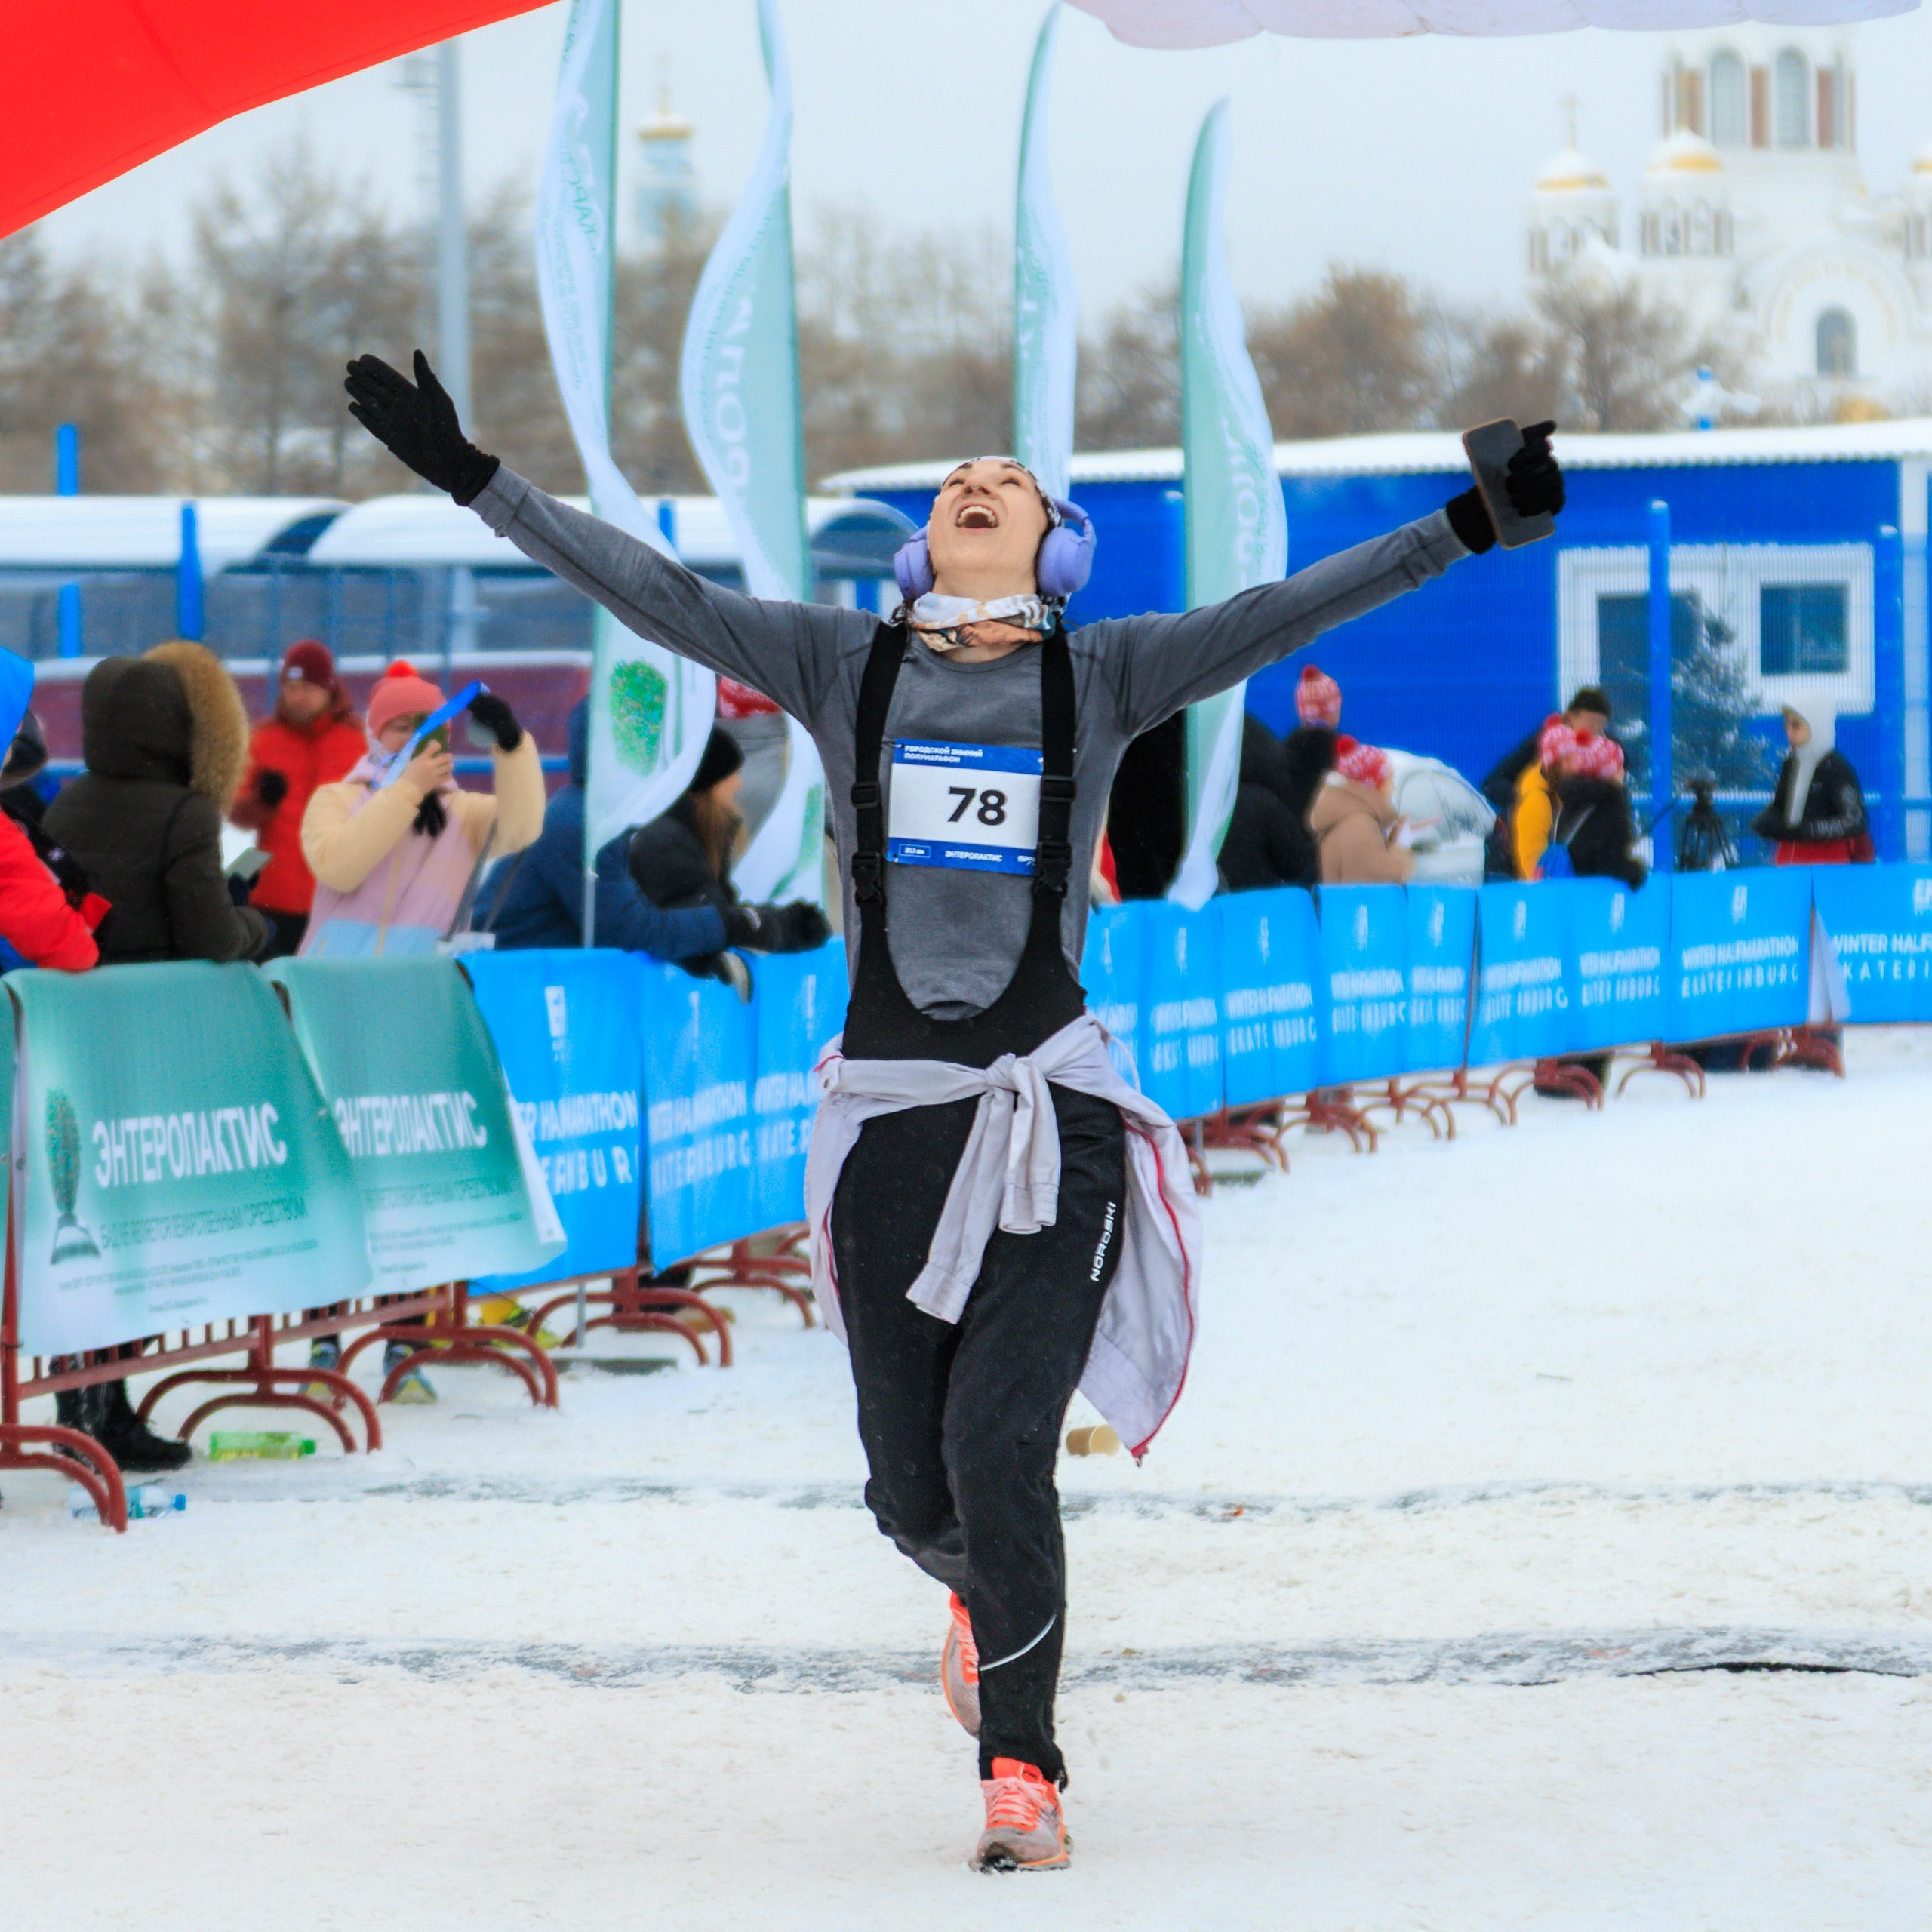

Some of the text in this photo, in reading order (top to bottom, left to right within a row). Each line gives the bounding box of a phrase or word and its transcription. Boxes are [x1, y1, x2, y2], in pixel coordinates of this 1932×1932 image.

[904, 745, 983, 758] ГОРОДСКОЙ ЗИМНИЙ
[904, 752, 961, 763] ПОЛУМАРАФОН
[947, 786, 1007, 826] 78
[1090, 1201, 1117, 1282] NORDSKI
